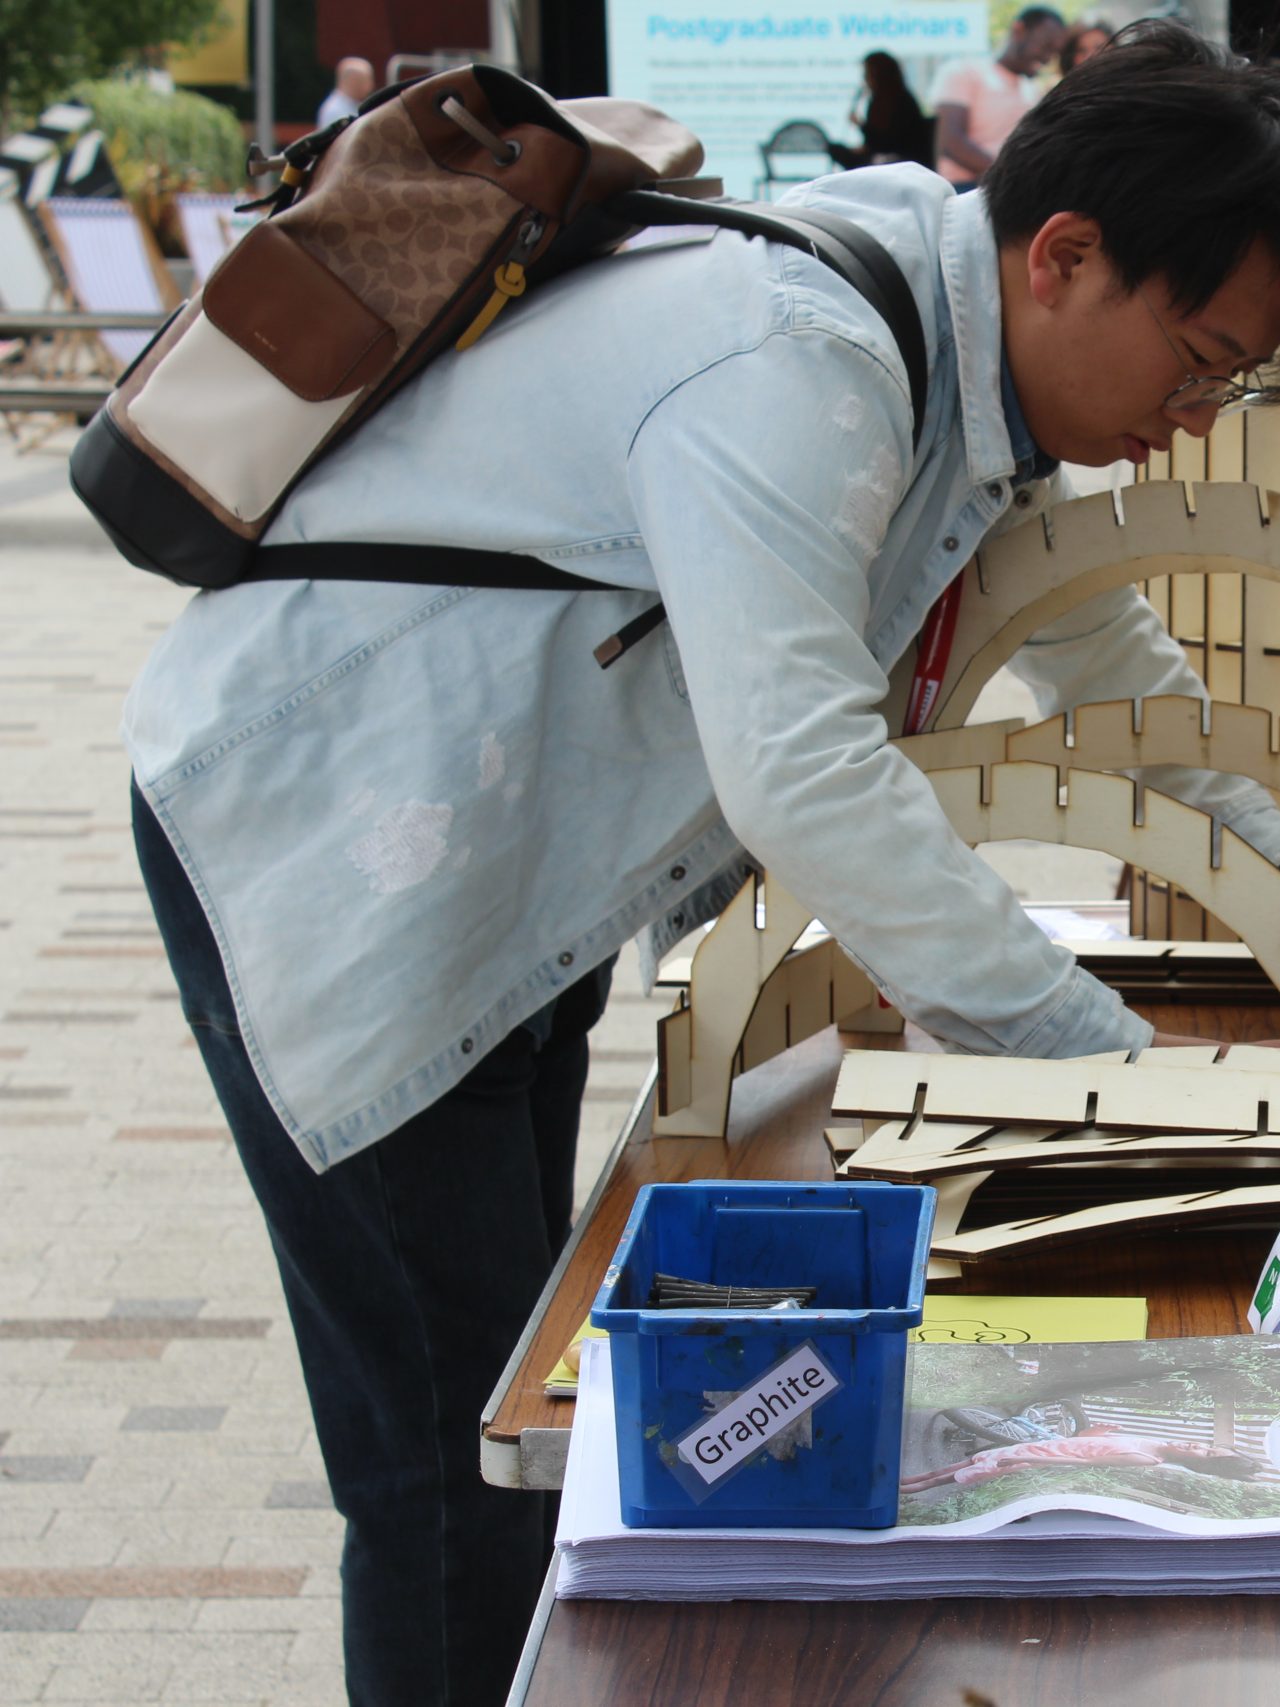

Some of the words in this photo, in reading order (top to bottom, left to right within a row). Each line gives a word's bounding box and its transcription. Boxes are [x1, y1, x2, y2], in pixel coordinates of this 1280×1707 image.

[648, 14, 833, 45] Postgraduate
[841, 14, 968, 39] Webinars
[694, 1364, 826, 1466] Graphite
